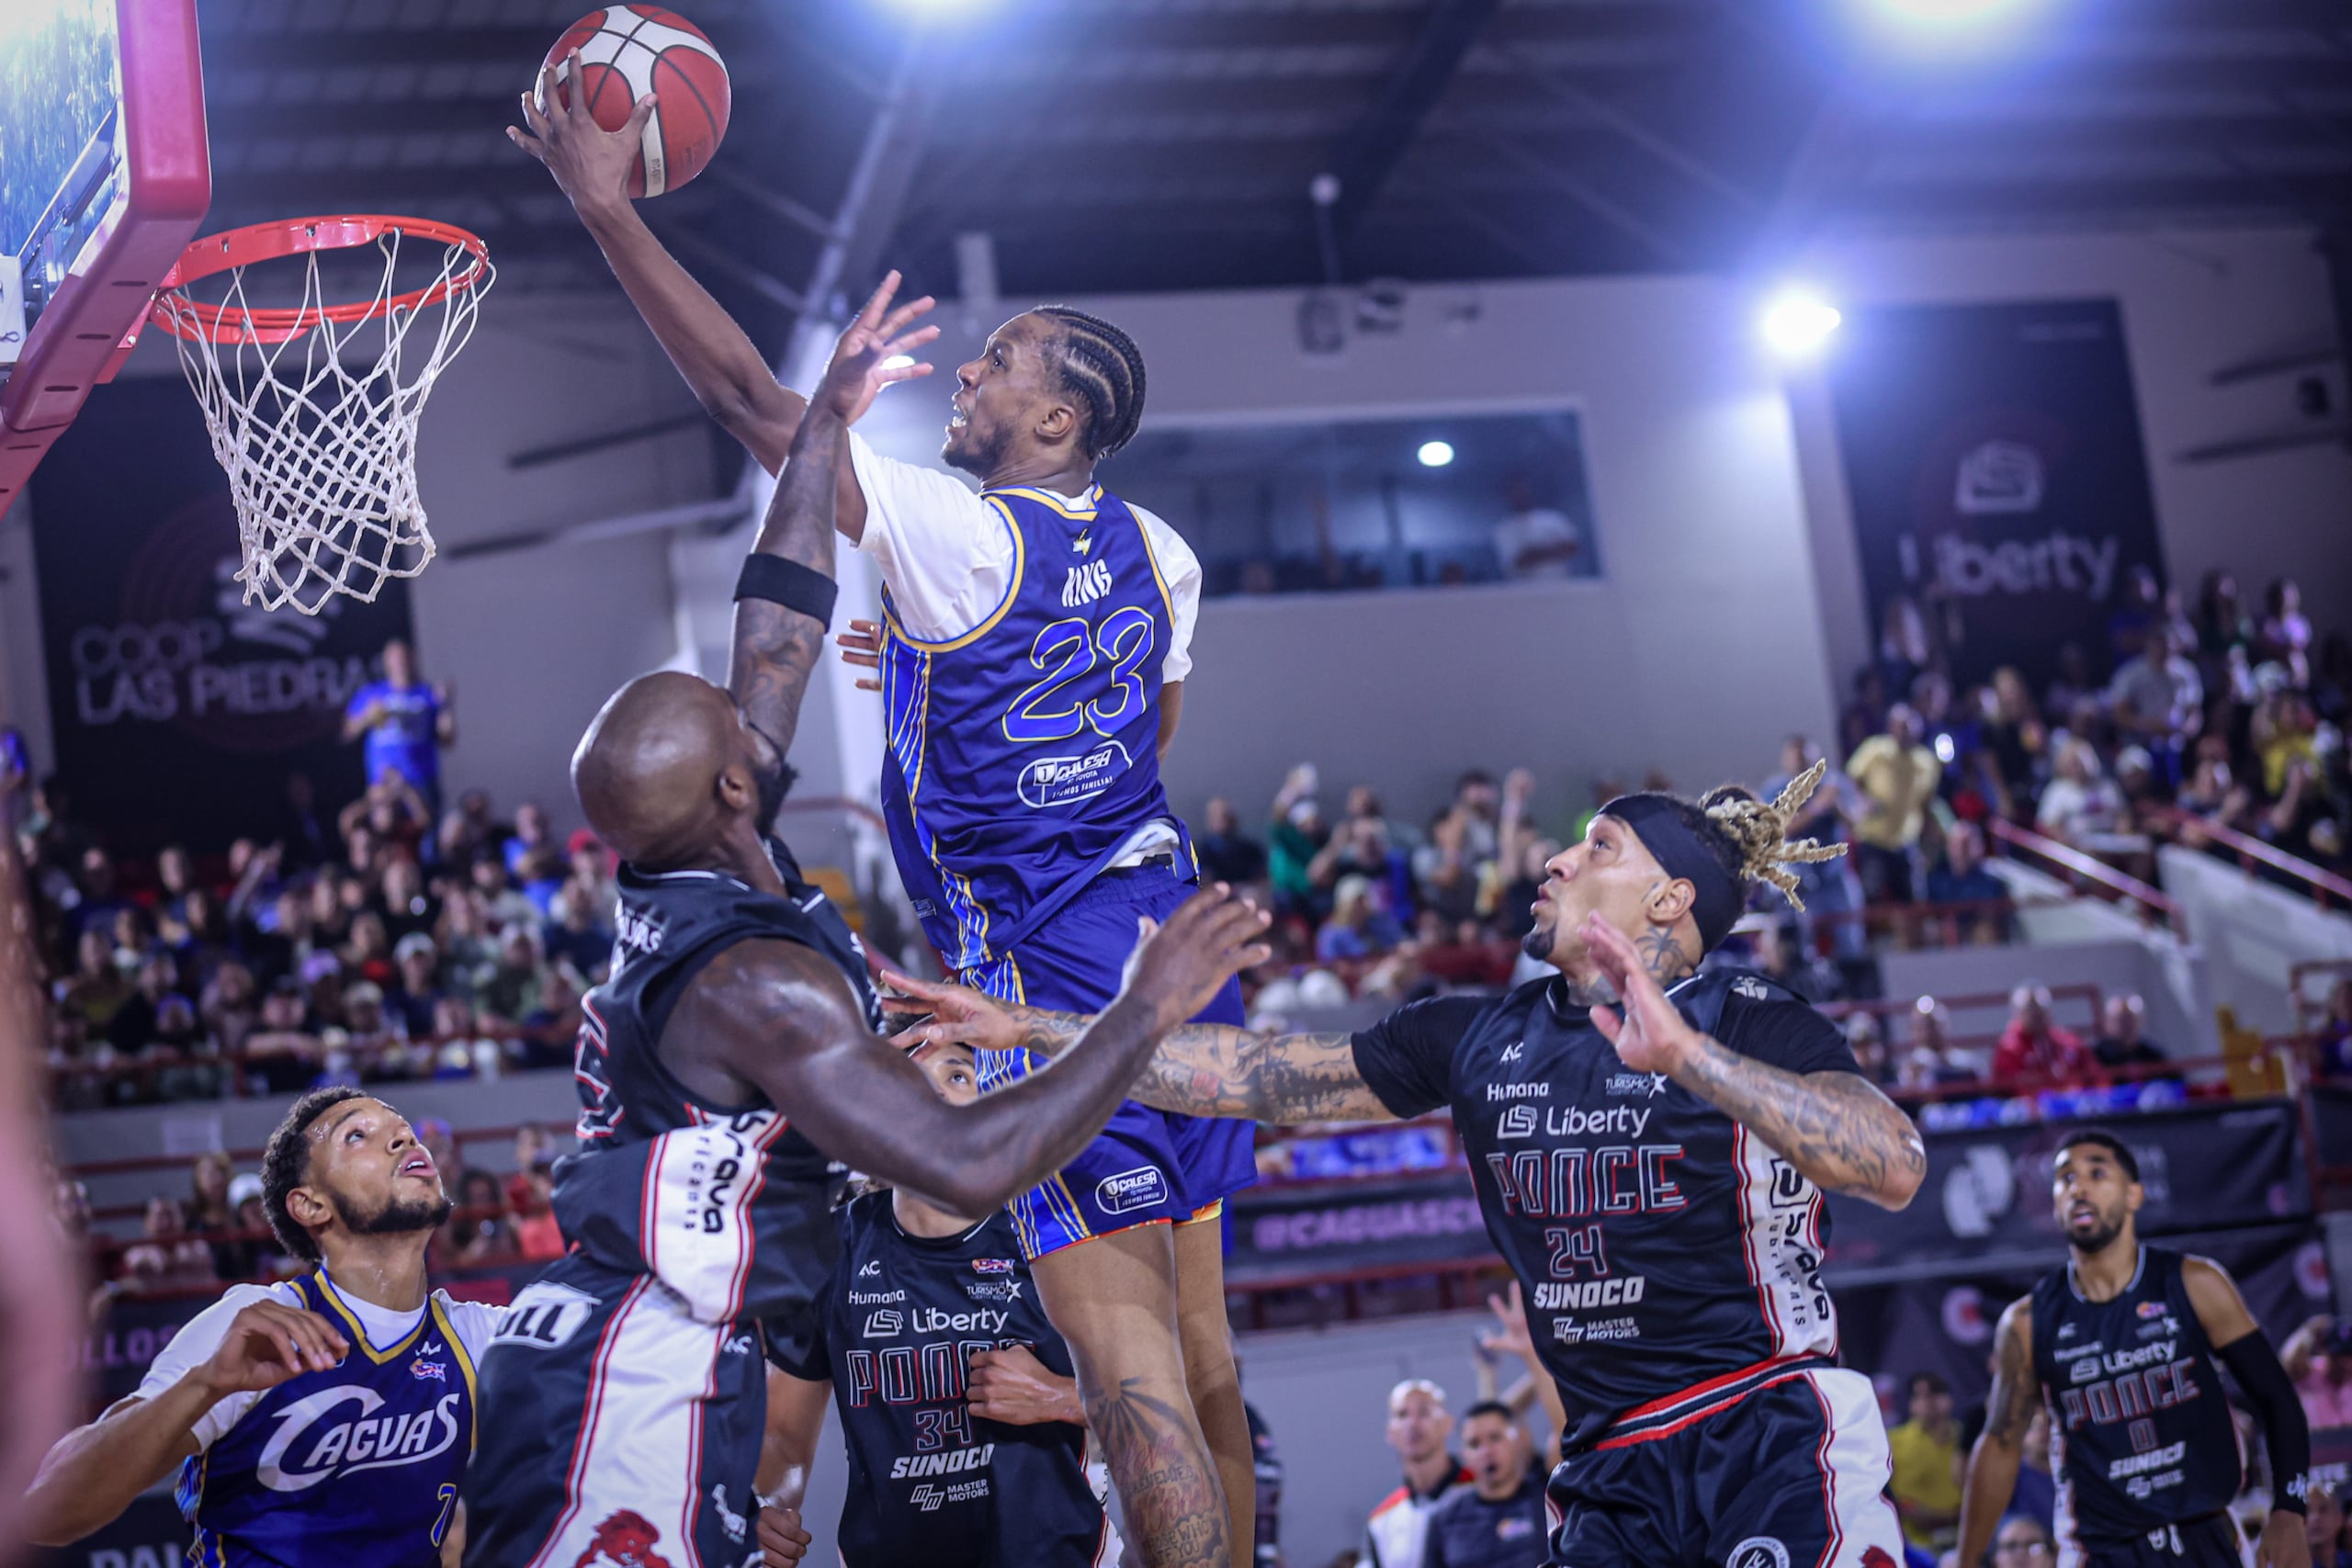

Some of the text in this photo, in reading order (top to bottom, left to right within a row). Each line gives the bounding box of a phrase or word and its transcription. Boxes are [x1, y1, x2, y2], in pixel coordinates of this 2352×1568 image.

[1002, 606, 1155, 741] 23
[77, 671, 178, 724] LAS
[1545, 1104, 1652, 1139] Liberty
[1118, 1171, 1158, 1193] CALESA
[1486, 1145, 1688, 1218] PONCE
[858, 1260, 880, 1276] AC
[1544, 1224, 1610, 1280] 24
[848, 1290, 906, 1305] Humana
[966, 1286, 1006, 1295] TURISMO
[1532, 1276, 1645, 1310] SUNOCO
[912, 1307, 1009, 1335] Liberty
[1586, 1325, 1640, 1341] MOTORS
[1587, 1317, 1634, 1331] MASTER
[2102, 1339, 2178, 1374] Liberty
[2059, 1356, 2200, 1431] PONCE
[256, 1384, 460, 1493] CAGUAS
[913, 1403, 974, 1452] 34
[889, 1443, 995, 1479] SUNOCO
[946, 1479, 988, 1494] MASTER
[948, 1488, 989, 1503] MOTORS
[430, 1483, 457, 1548] 7
